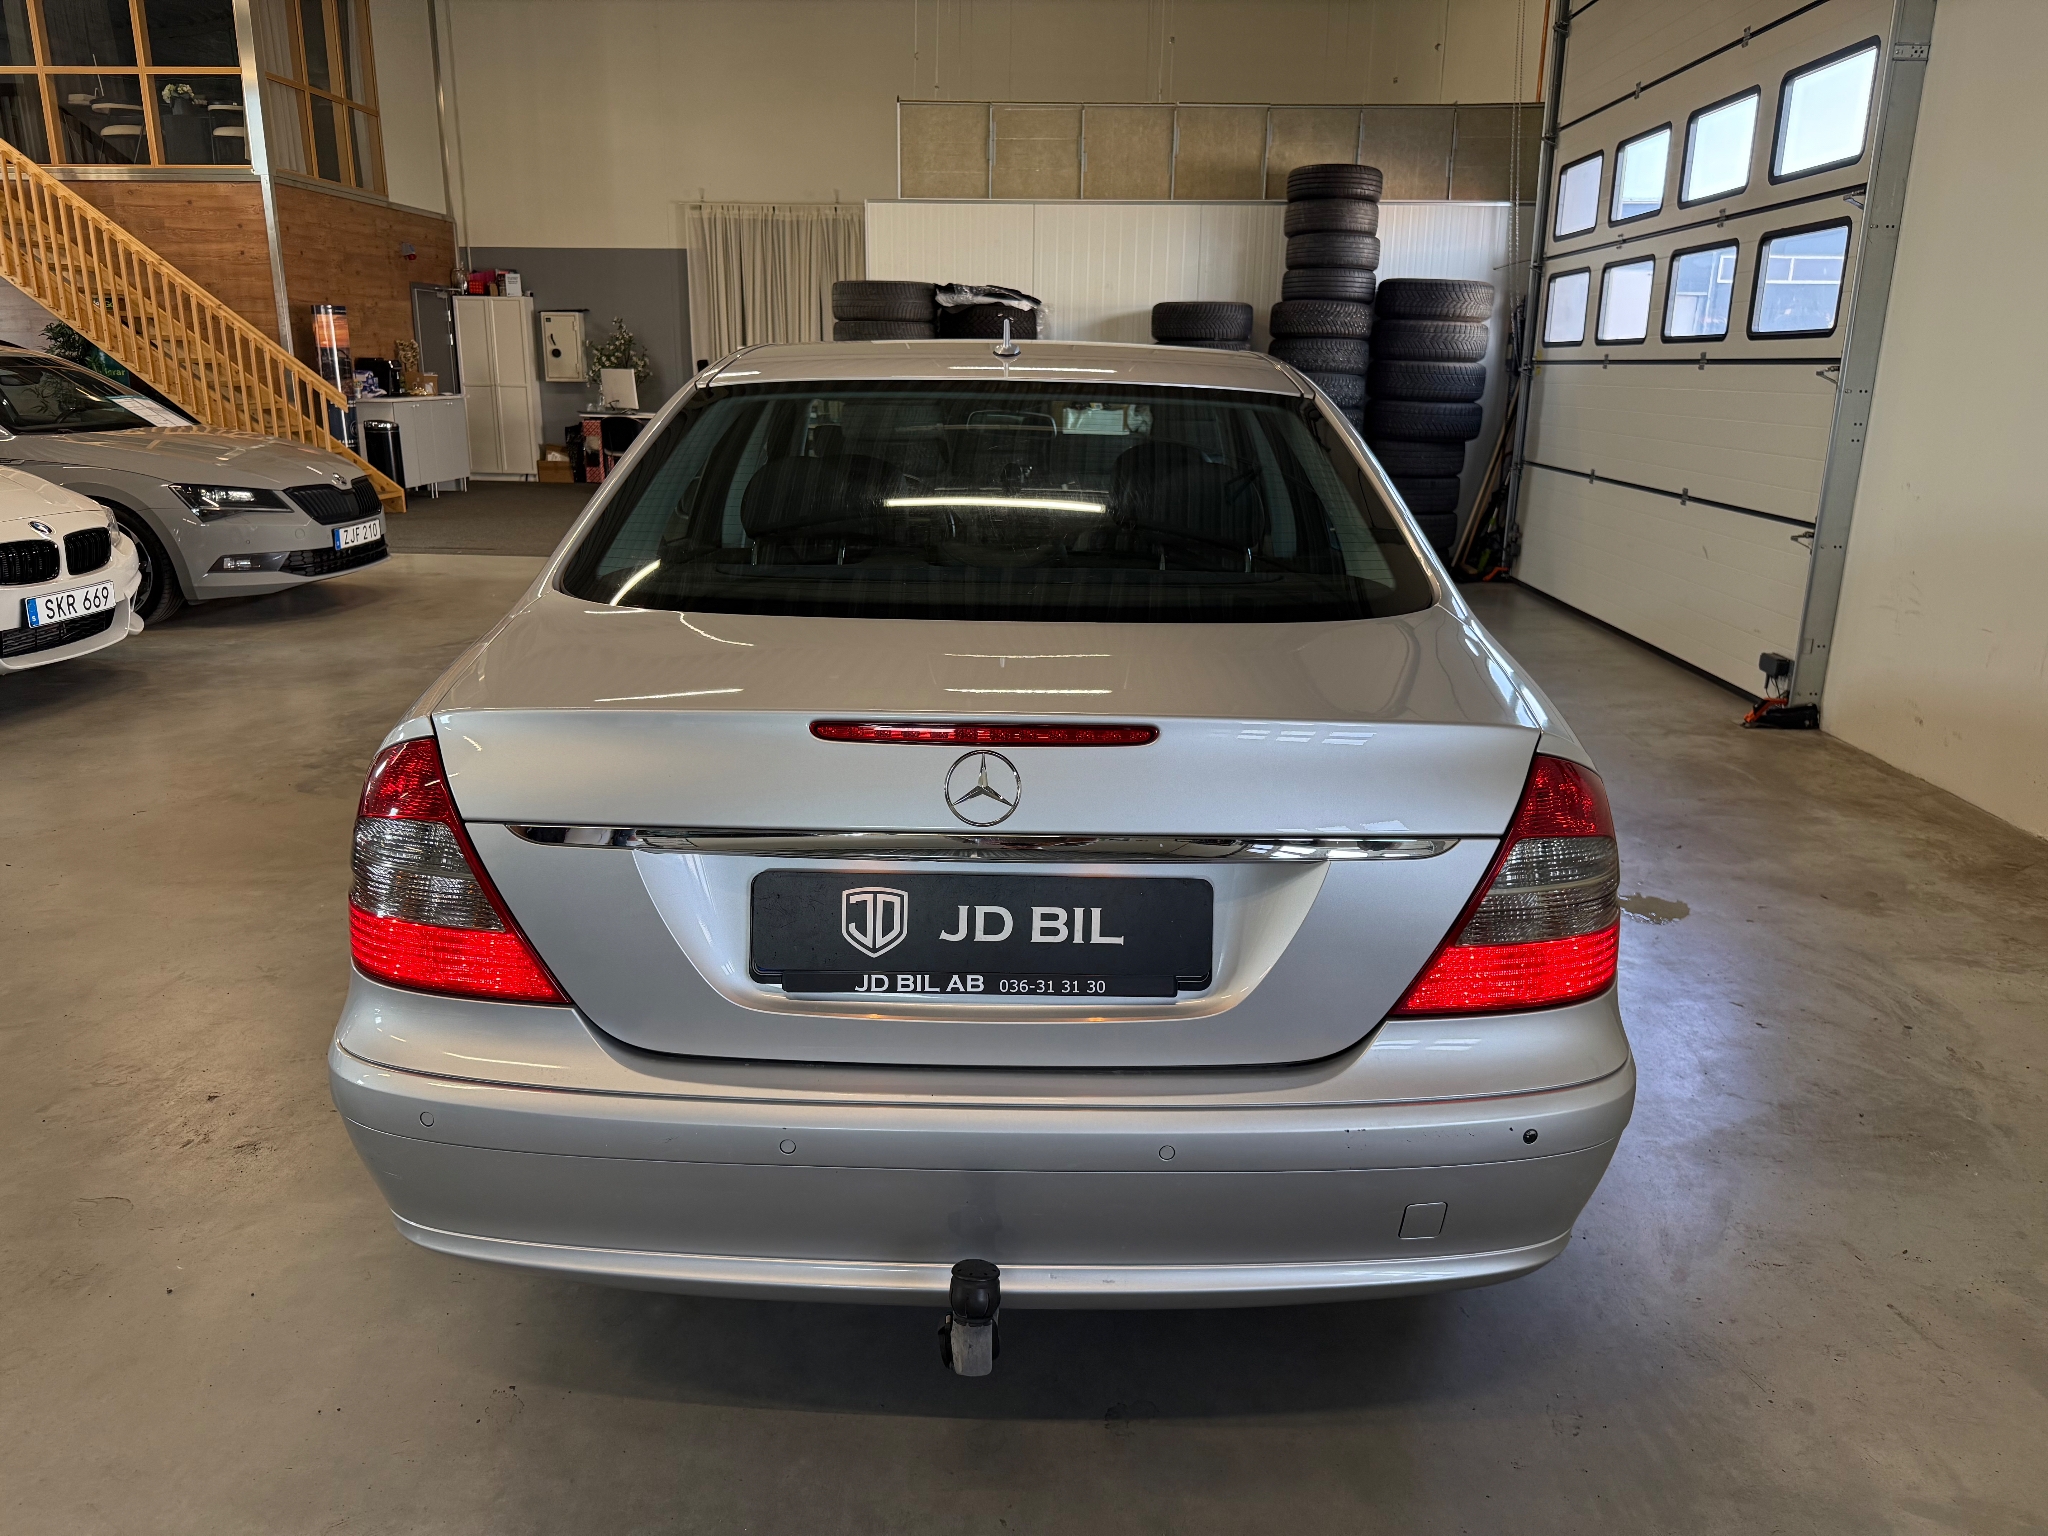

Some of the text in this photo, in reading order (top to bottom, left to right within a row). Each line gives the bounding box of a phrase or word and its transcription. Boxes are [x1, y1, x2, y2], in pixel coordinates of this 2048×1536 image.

[343, 522, 378, 545] ZJF 210
[45, 586, 109, 619] SKR 669
[848, 893, 901, 949] JD
[939, 905, 1125, 946] JD BIL
[854, 974, 1107, 994] JD BIL AB 036-31 31 30
